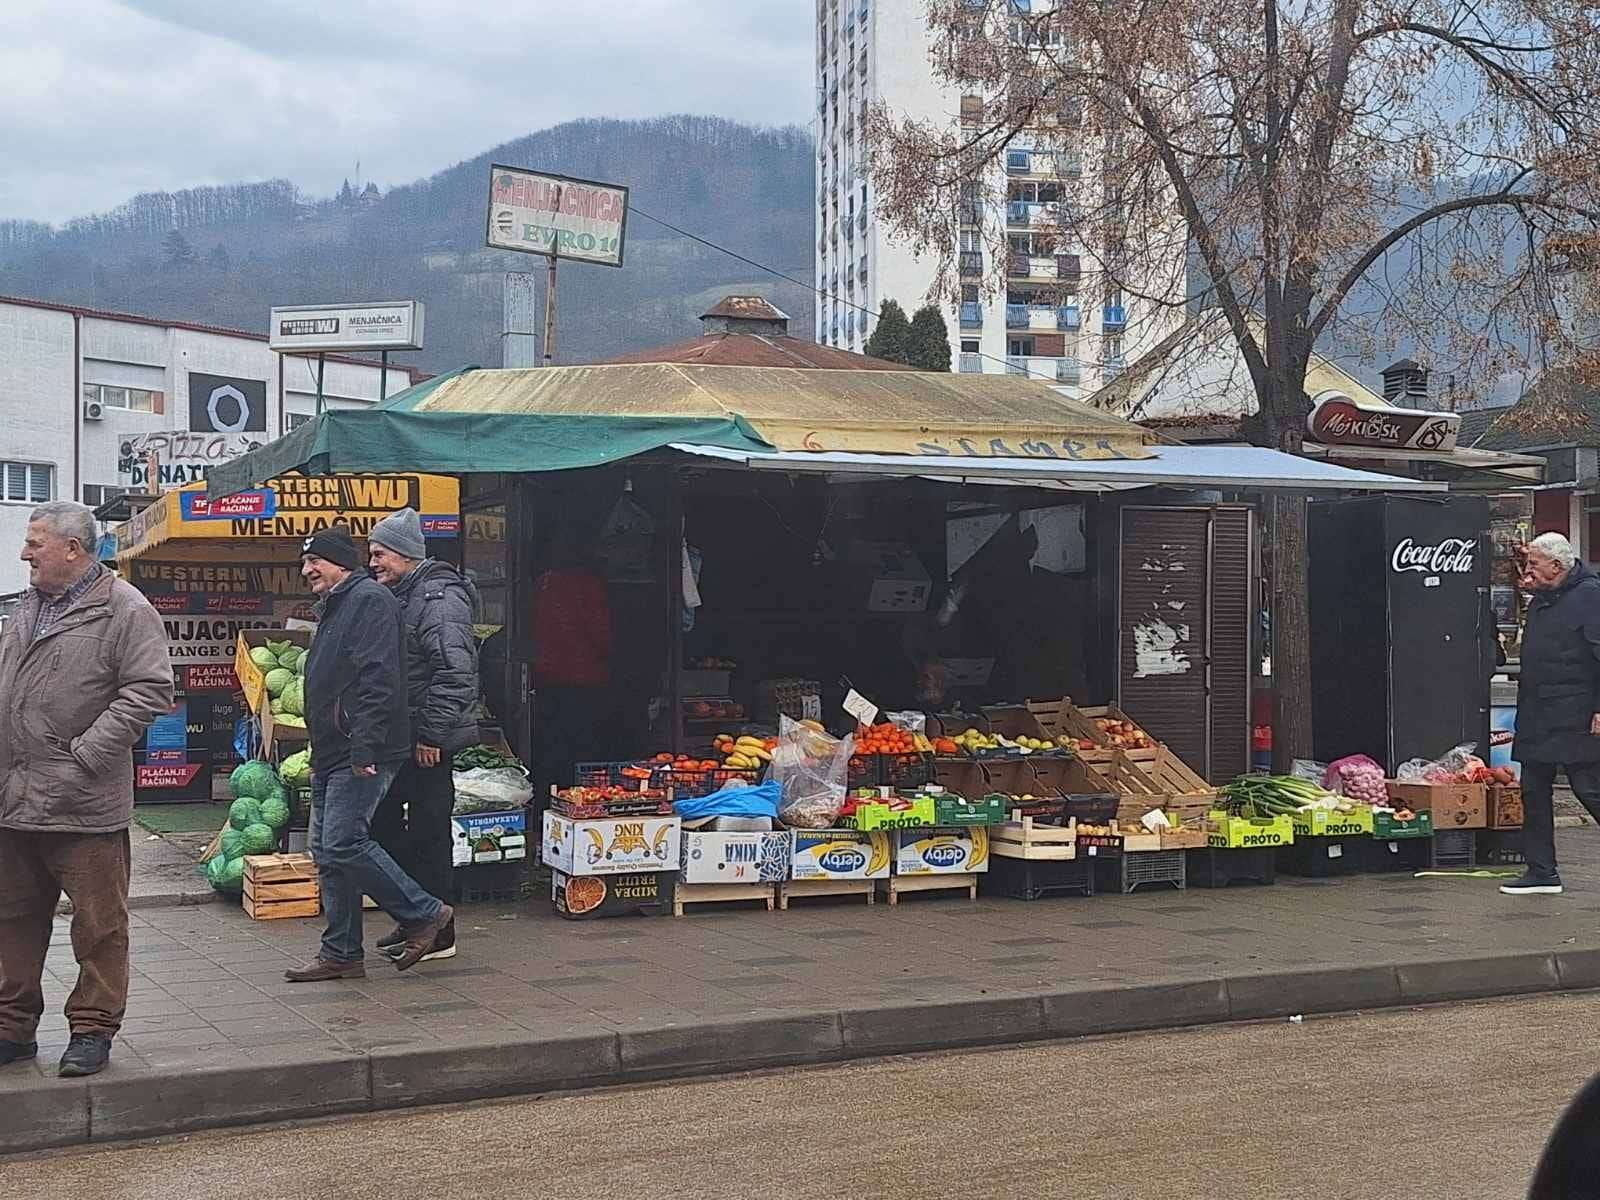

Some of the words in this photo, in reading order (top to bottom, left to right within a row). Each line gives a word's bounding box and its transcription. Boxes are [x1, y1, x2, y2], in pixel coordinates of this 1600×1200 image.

[522, 223, 596, 250] EVRO
[348, 315, 402, 325] MENJAČNICA
[1323, 412, 1352, 436] Moj
[255, 479, 339, 493] STERN
[350, 479, 409, 508] WU
[232, 511, 384, 536] MENJAČNI
[1392, 538, 1477, 572] Coca-Cola
[139, 565, 247, 581] WESTERN
[174, 580, 247, 592] UNION
[190, 676, 232, 687] RAČUNA
[185, 724, 204, 733] WU
[141, 766, 187, 777] PLAĆANJE
[141, 776, 178, 786] RAČUNA
[468, 815, 520, 826] ALEXANDRIA
[880, 812, 921, 830] PRÓTO
[1326, 818, 1362, 834] PRÓTO
[614, 823, 644, 838] KING
[1243, 828, 1281, 845] PRÓTO
[725, 843, 757, 862] KIKA
[822, 850, 863, 871] derby
[925, 847, 964, 865] derby
[616, 875, 656, 886] FRUIT
[614, 886, 658, 898] MIDEA
